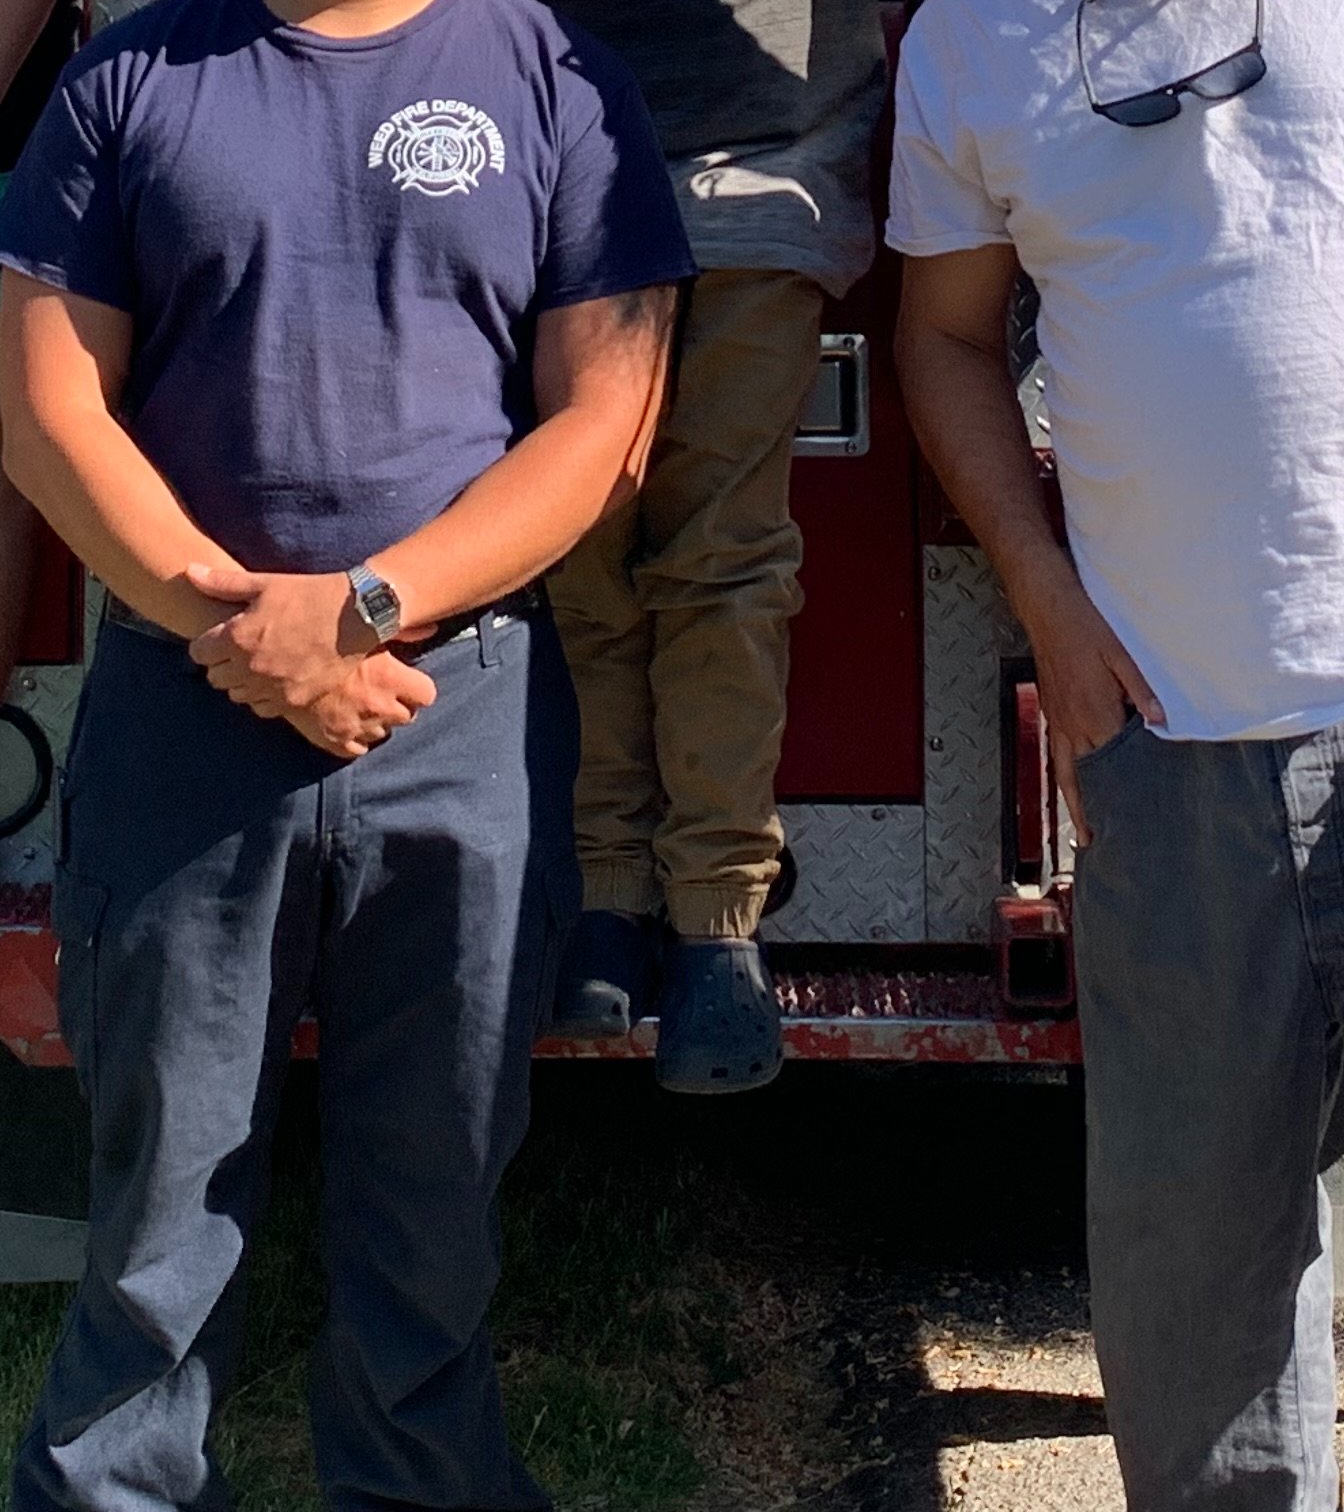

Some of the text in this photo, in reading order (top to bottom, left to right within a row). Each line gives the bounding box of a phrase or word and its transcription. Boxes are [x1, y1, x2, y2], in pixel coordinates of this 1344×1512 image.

[368, 99, 505, 174] WEED FIRE DEPARTMENT
